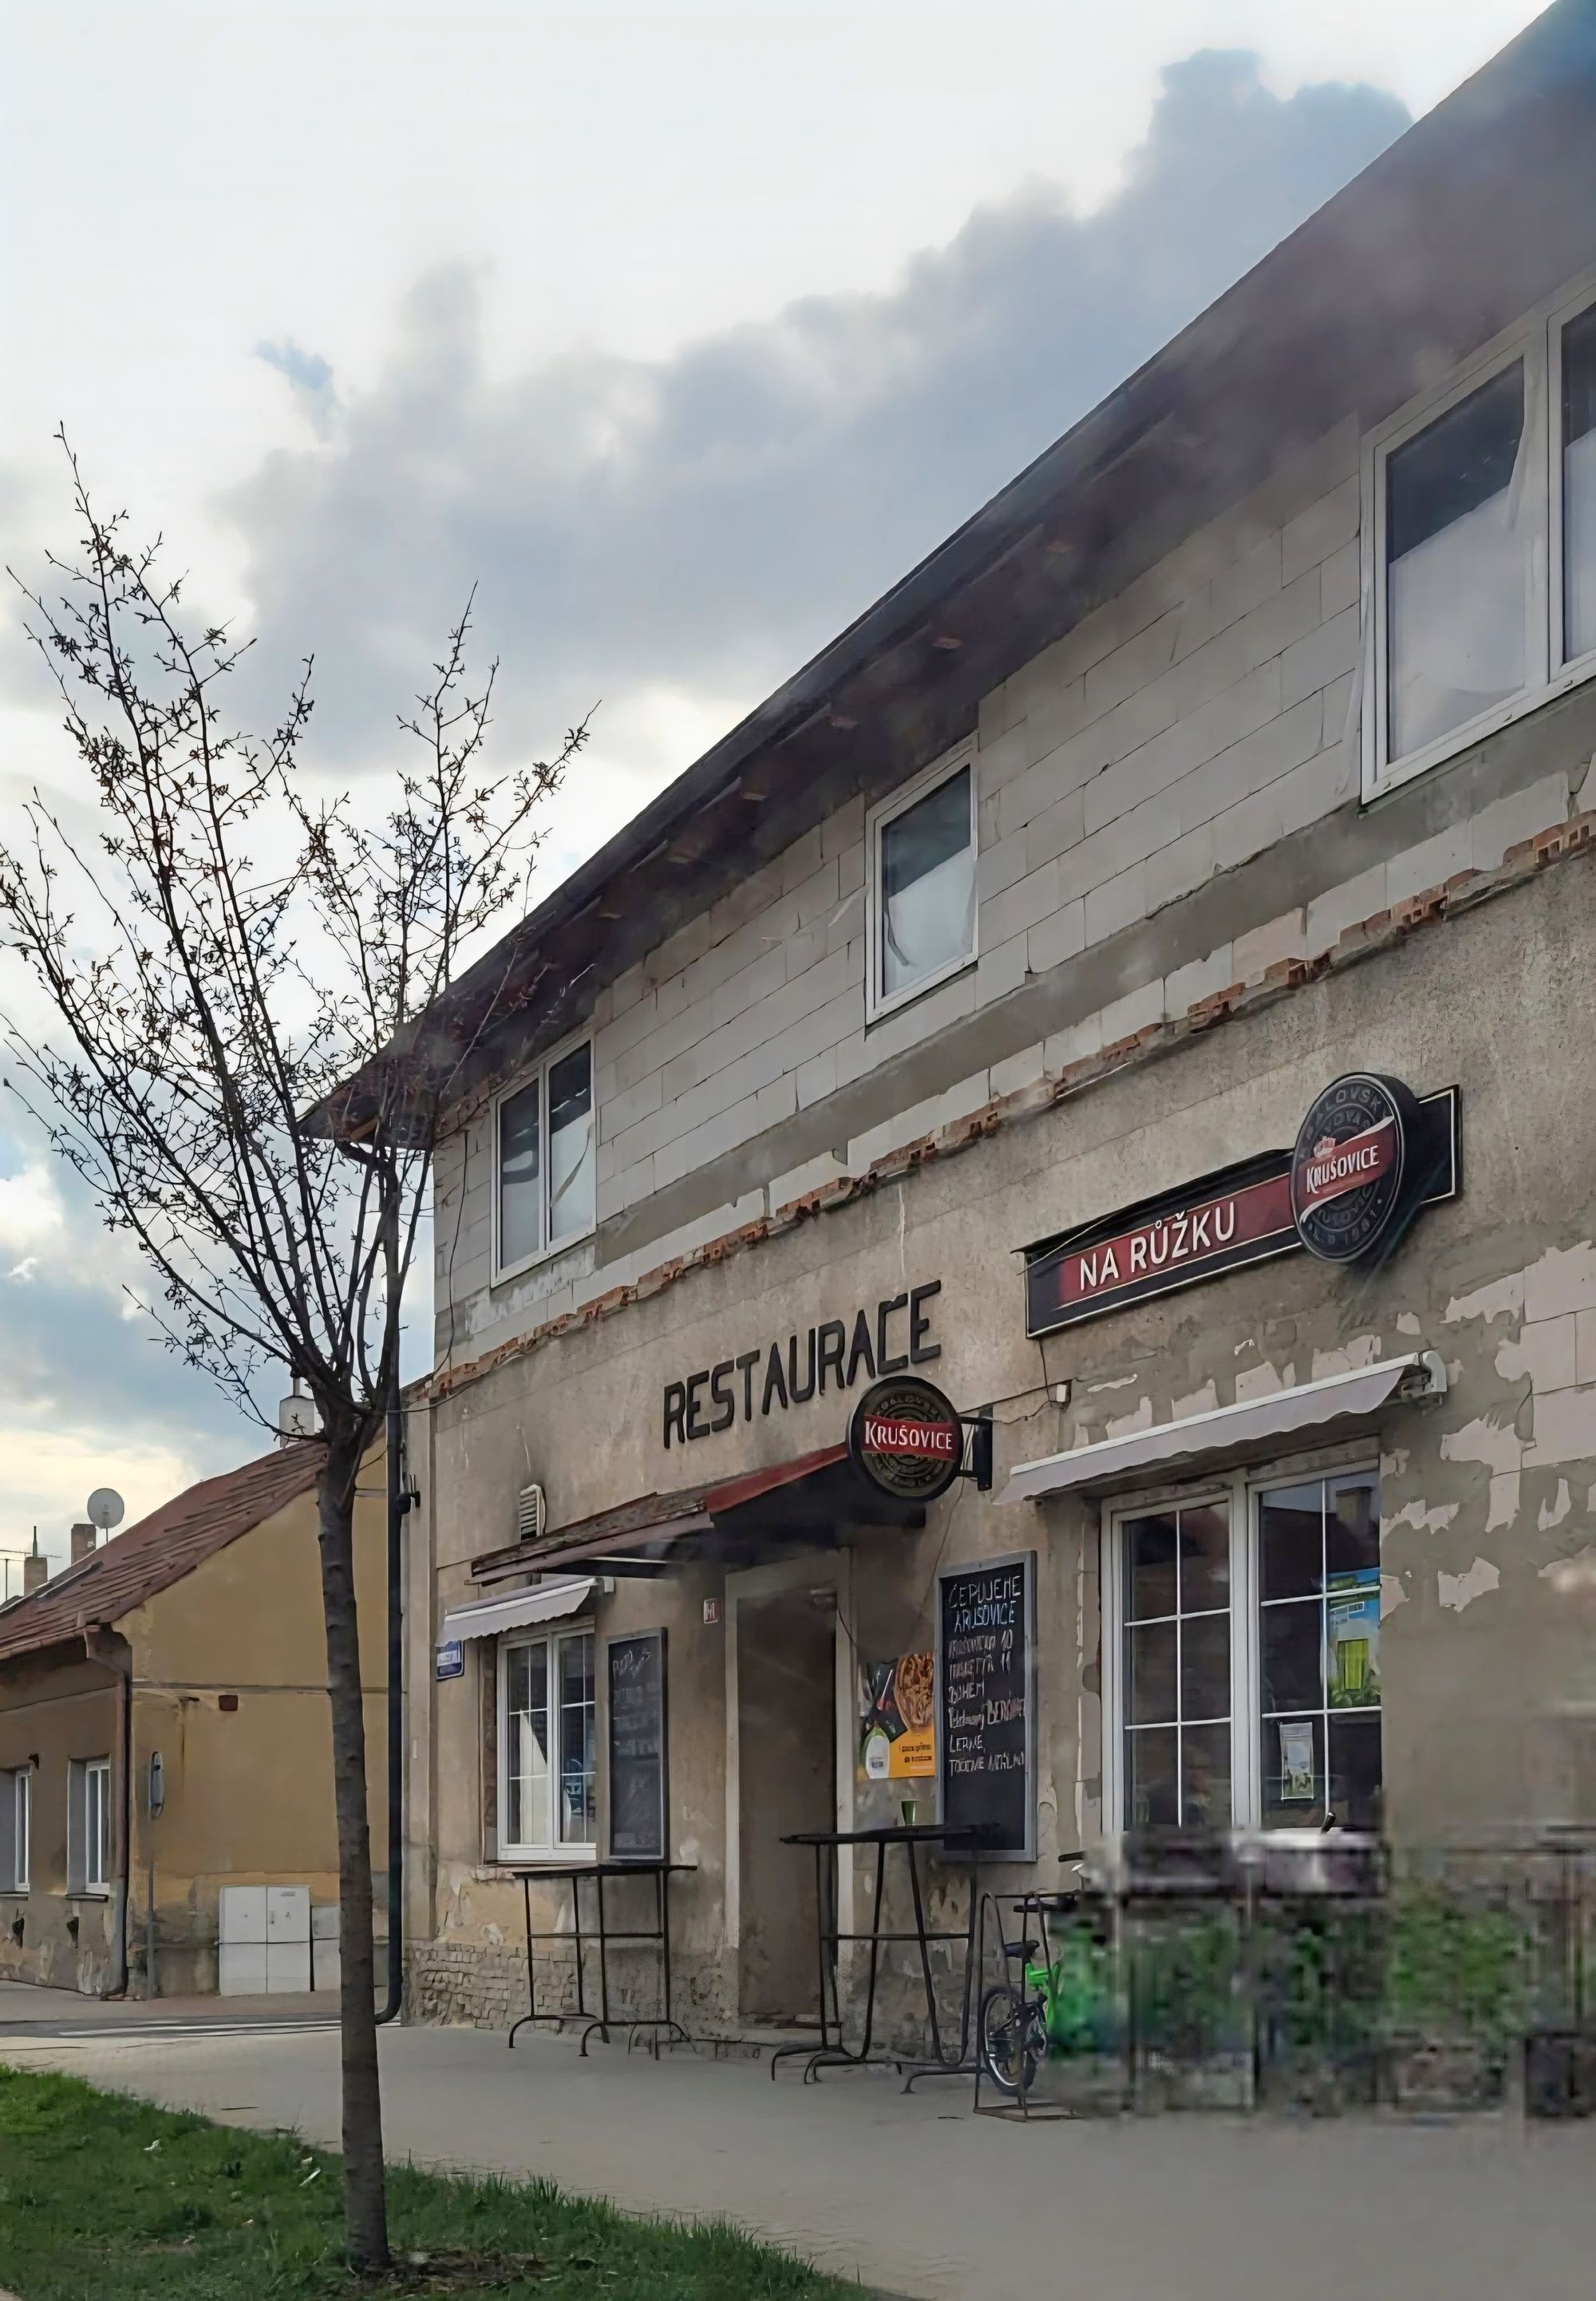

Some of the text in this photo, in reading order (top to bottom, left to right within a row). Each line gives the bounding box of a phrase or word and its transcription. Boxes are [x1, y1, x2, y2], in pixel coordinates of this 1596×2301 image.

[1080, 1201, 1235, 1291] NA RŮŽKU
[663, 1279, 941, 1449] RESTAURACE
[865, 1421, 953, 1449] KRUŠOVICE
